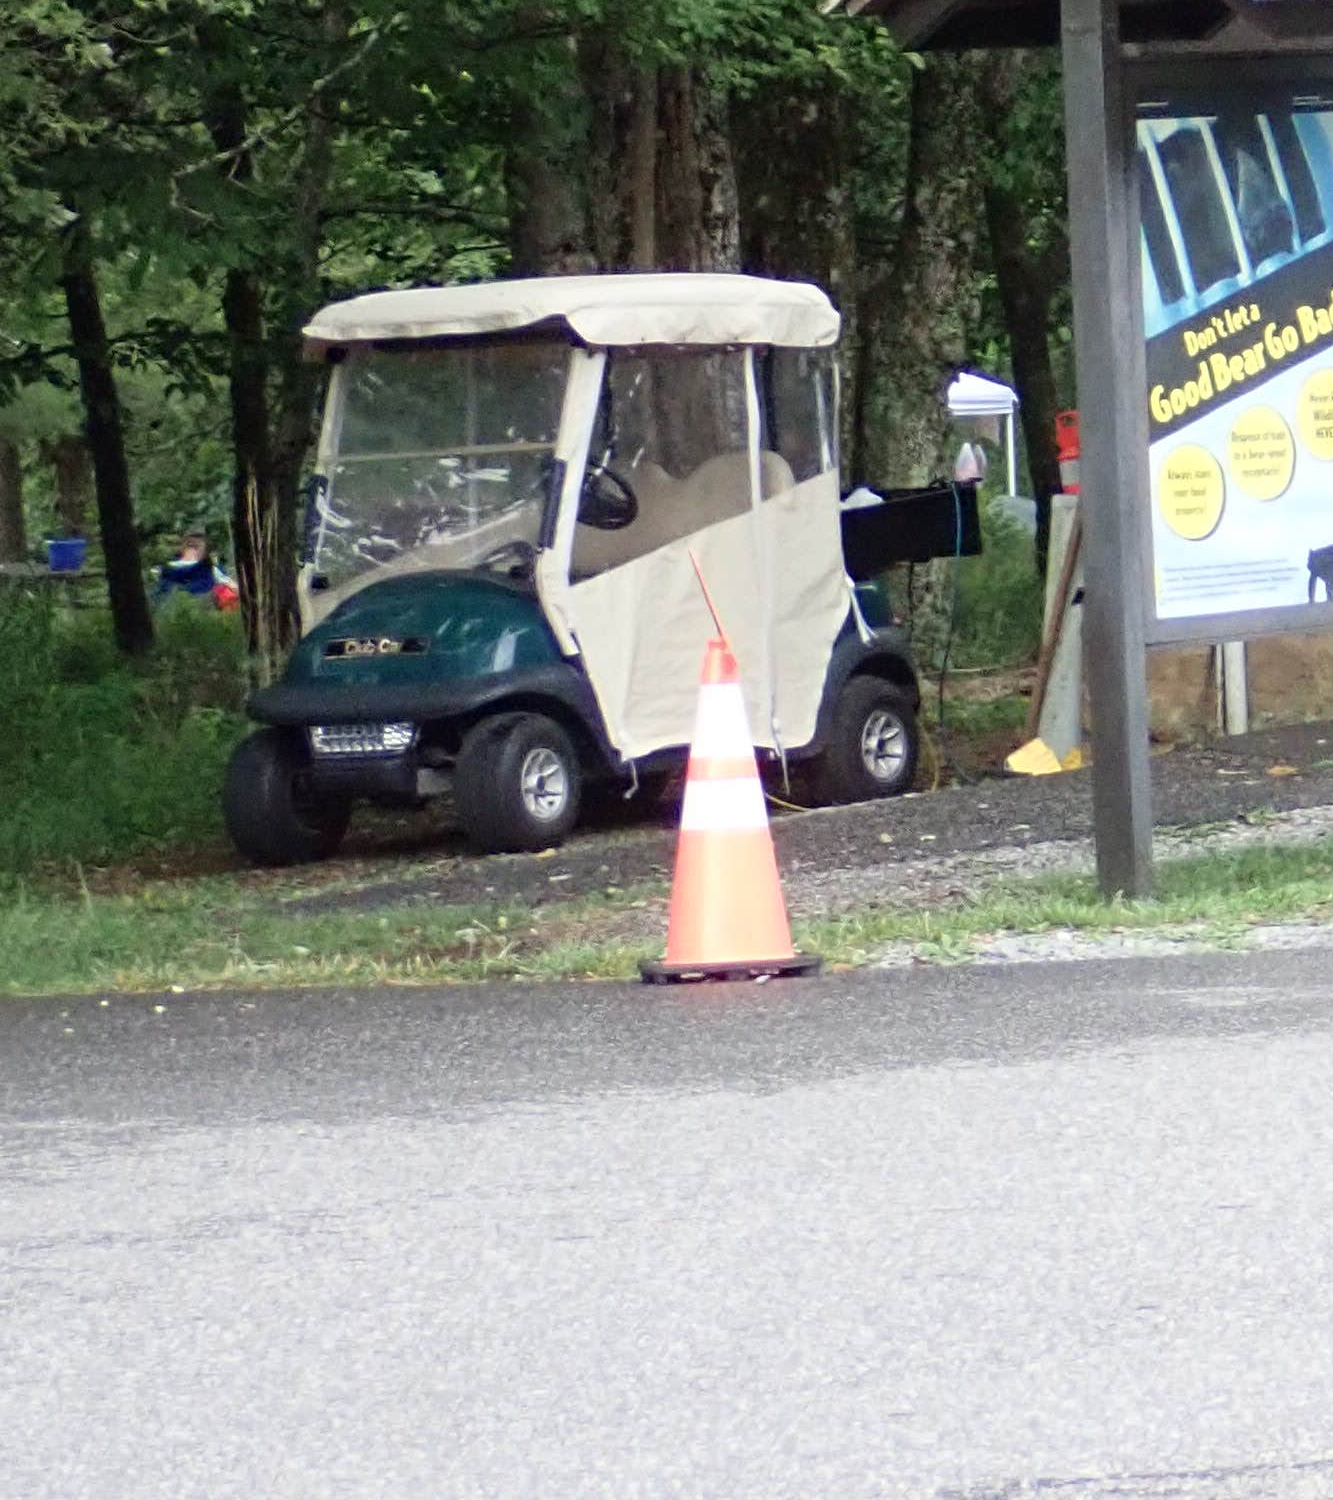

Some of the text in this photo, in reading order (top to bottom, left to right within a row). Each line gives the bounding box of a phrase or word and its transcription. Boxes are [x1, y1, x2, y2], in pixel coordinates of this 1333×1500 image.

[1184, 303, 1261, 357] Don't let a
[1150, 360, 1214, 423] Good
[1209, 341, 1266, 392] Bear
[1264, 322, 1300, 360] Go
